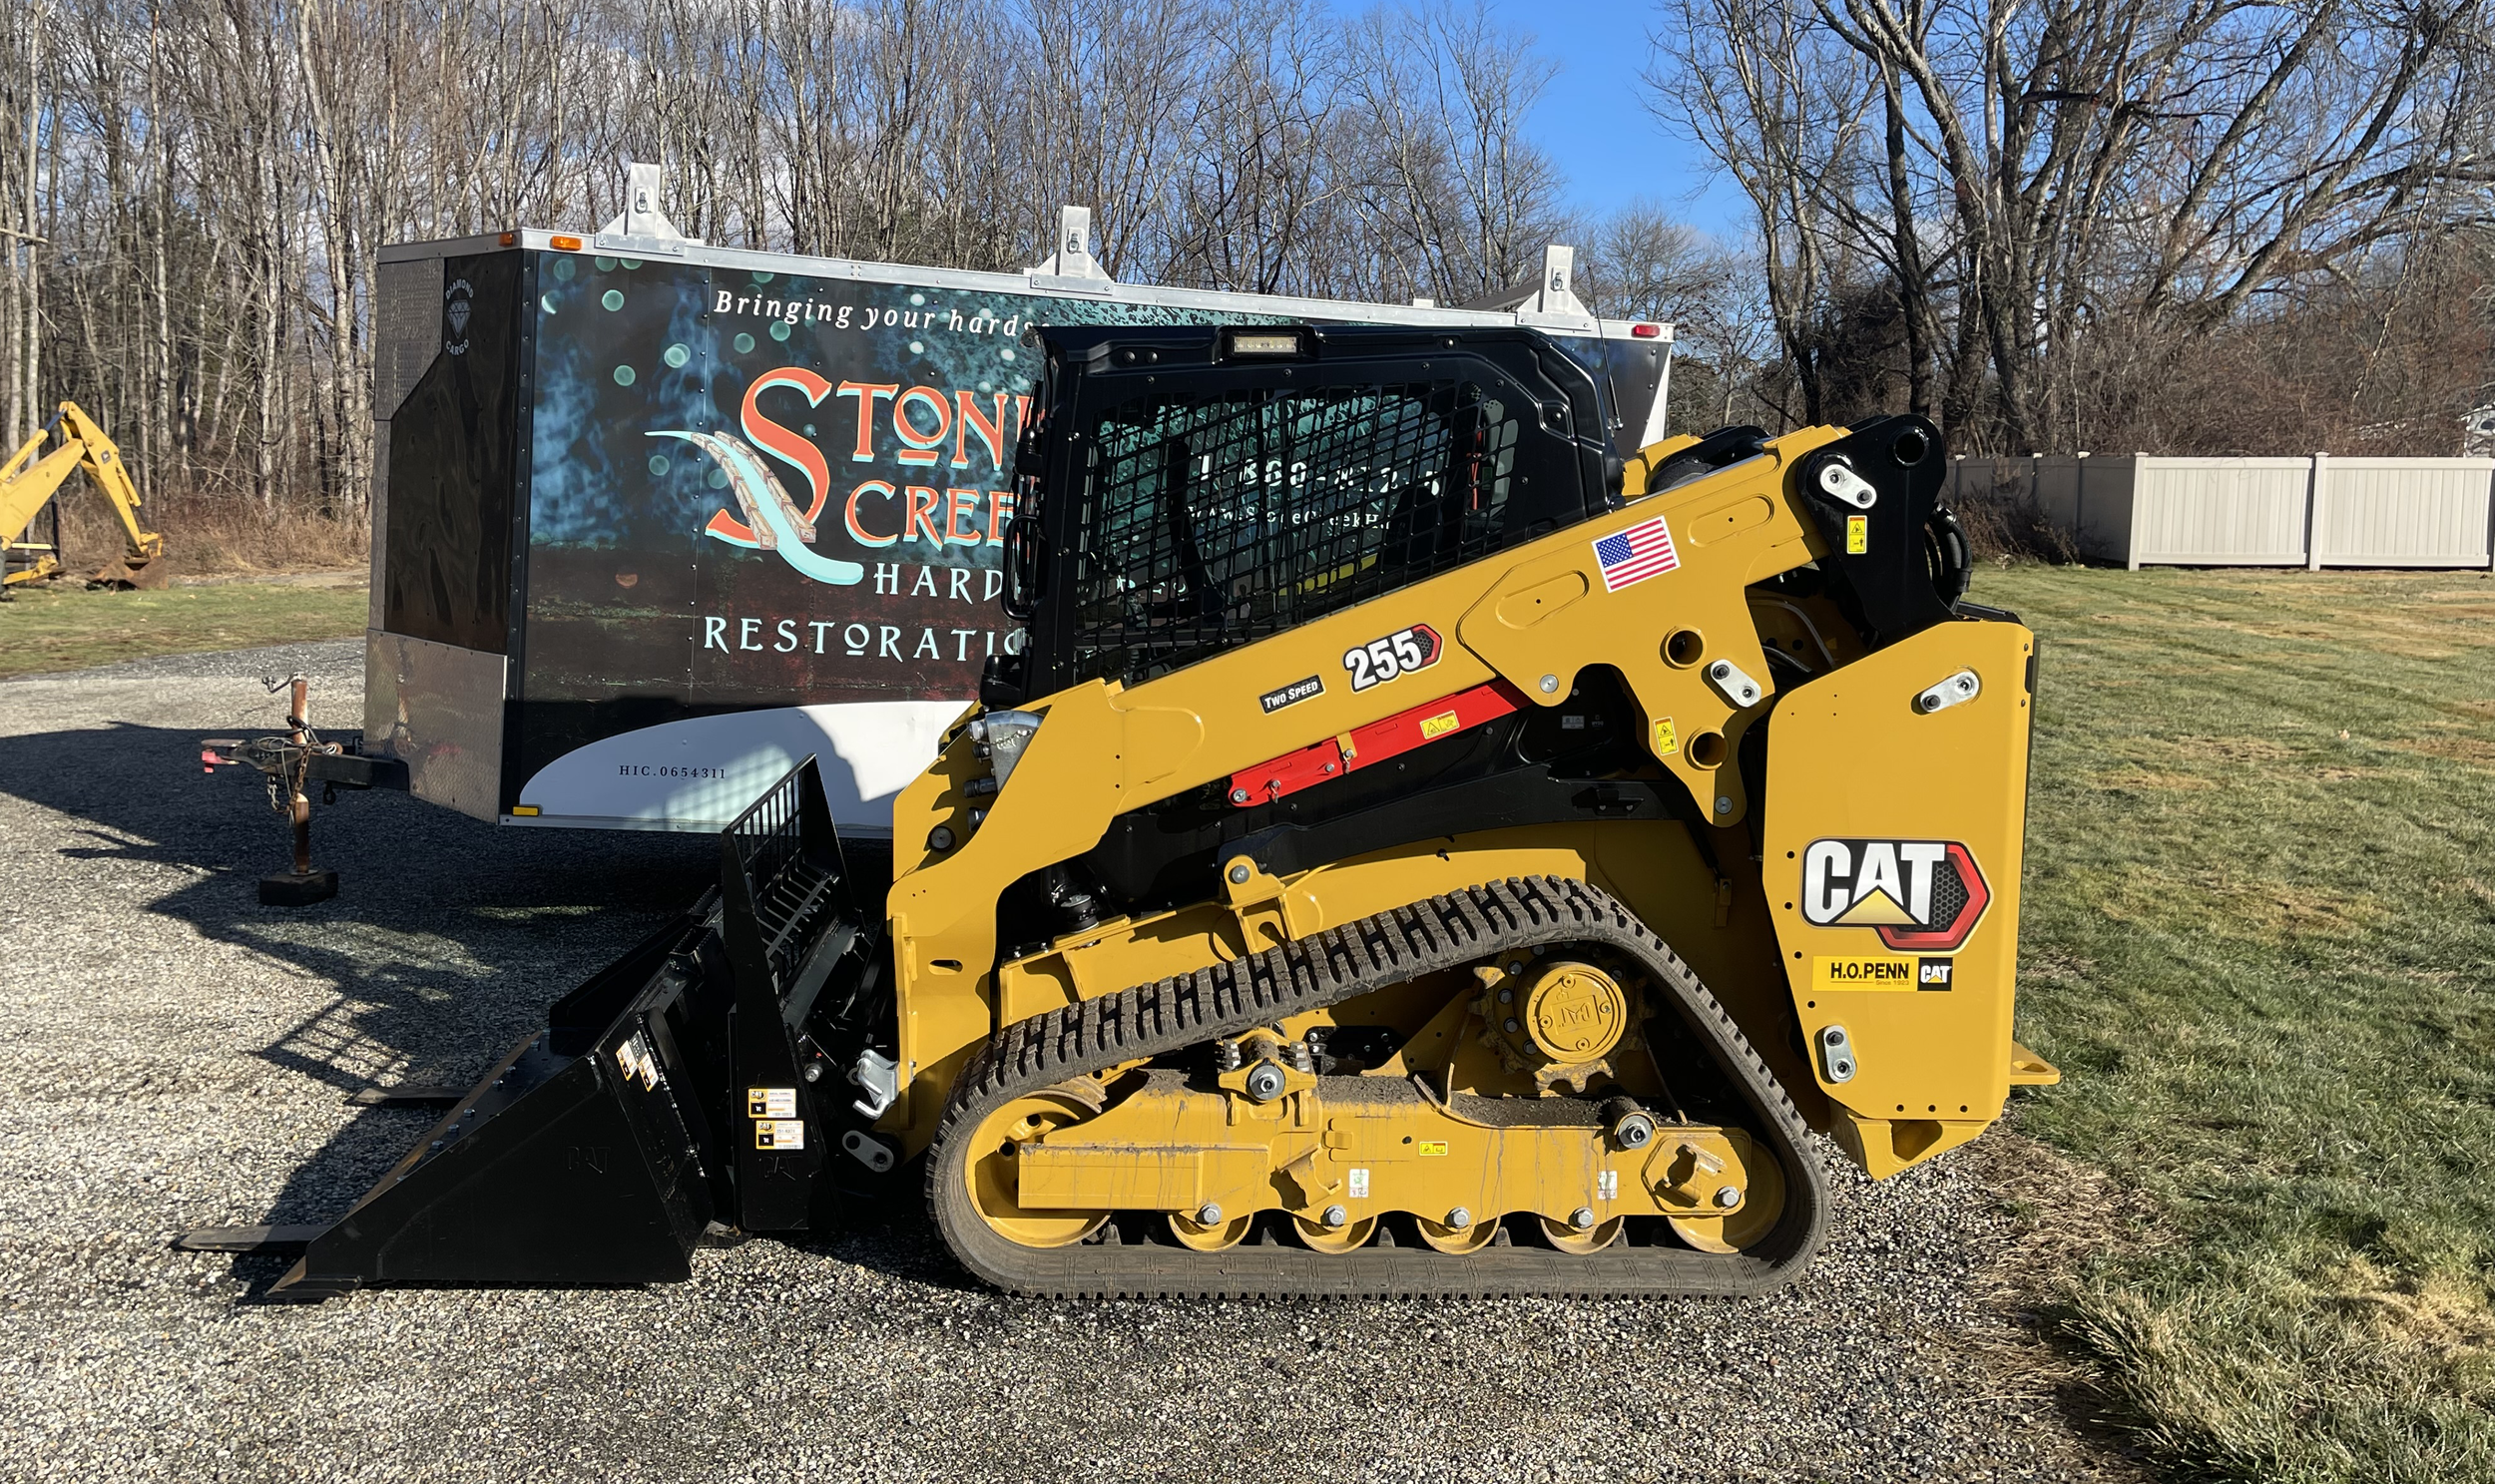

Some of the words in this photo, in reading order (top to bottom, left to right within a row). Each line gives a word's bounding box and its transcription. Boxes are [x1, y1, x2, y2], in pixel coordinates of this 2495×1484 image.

[445, 278, 474, 299] DIAMOND
[714, 289, 853, 329] Bringing
[860, 299, 936, 330] your
[445, 339, 470, 355] CARGO
[1344, 630, 1422, 691] 255
[1804, 840, 1945, 925] CAT
[1830, 962, 1910, 979] H.O.PENN
[1920, 965, 1951, 984] CAT
